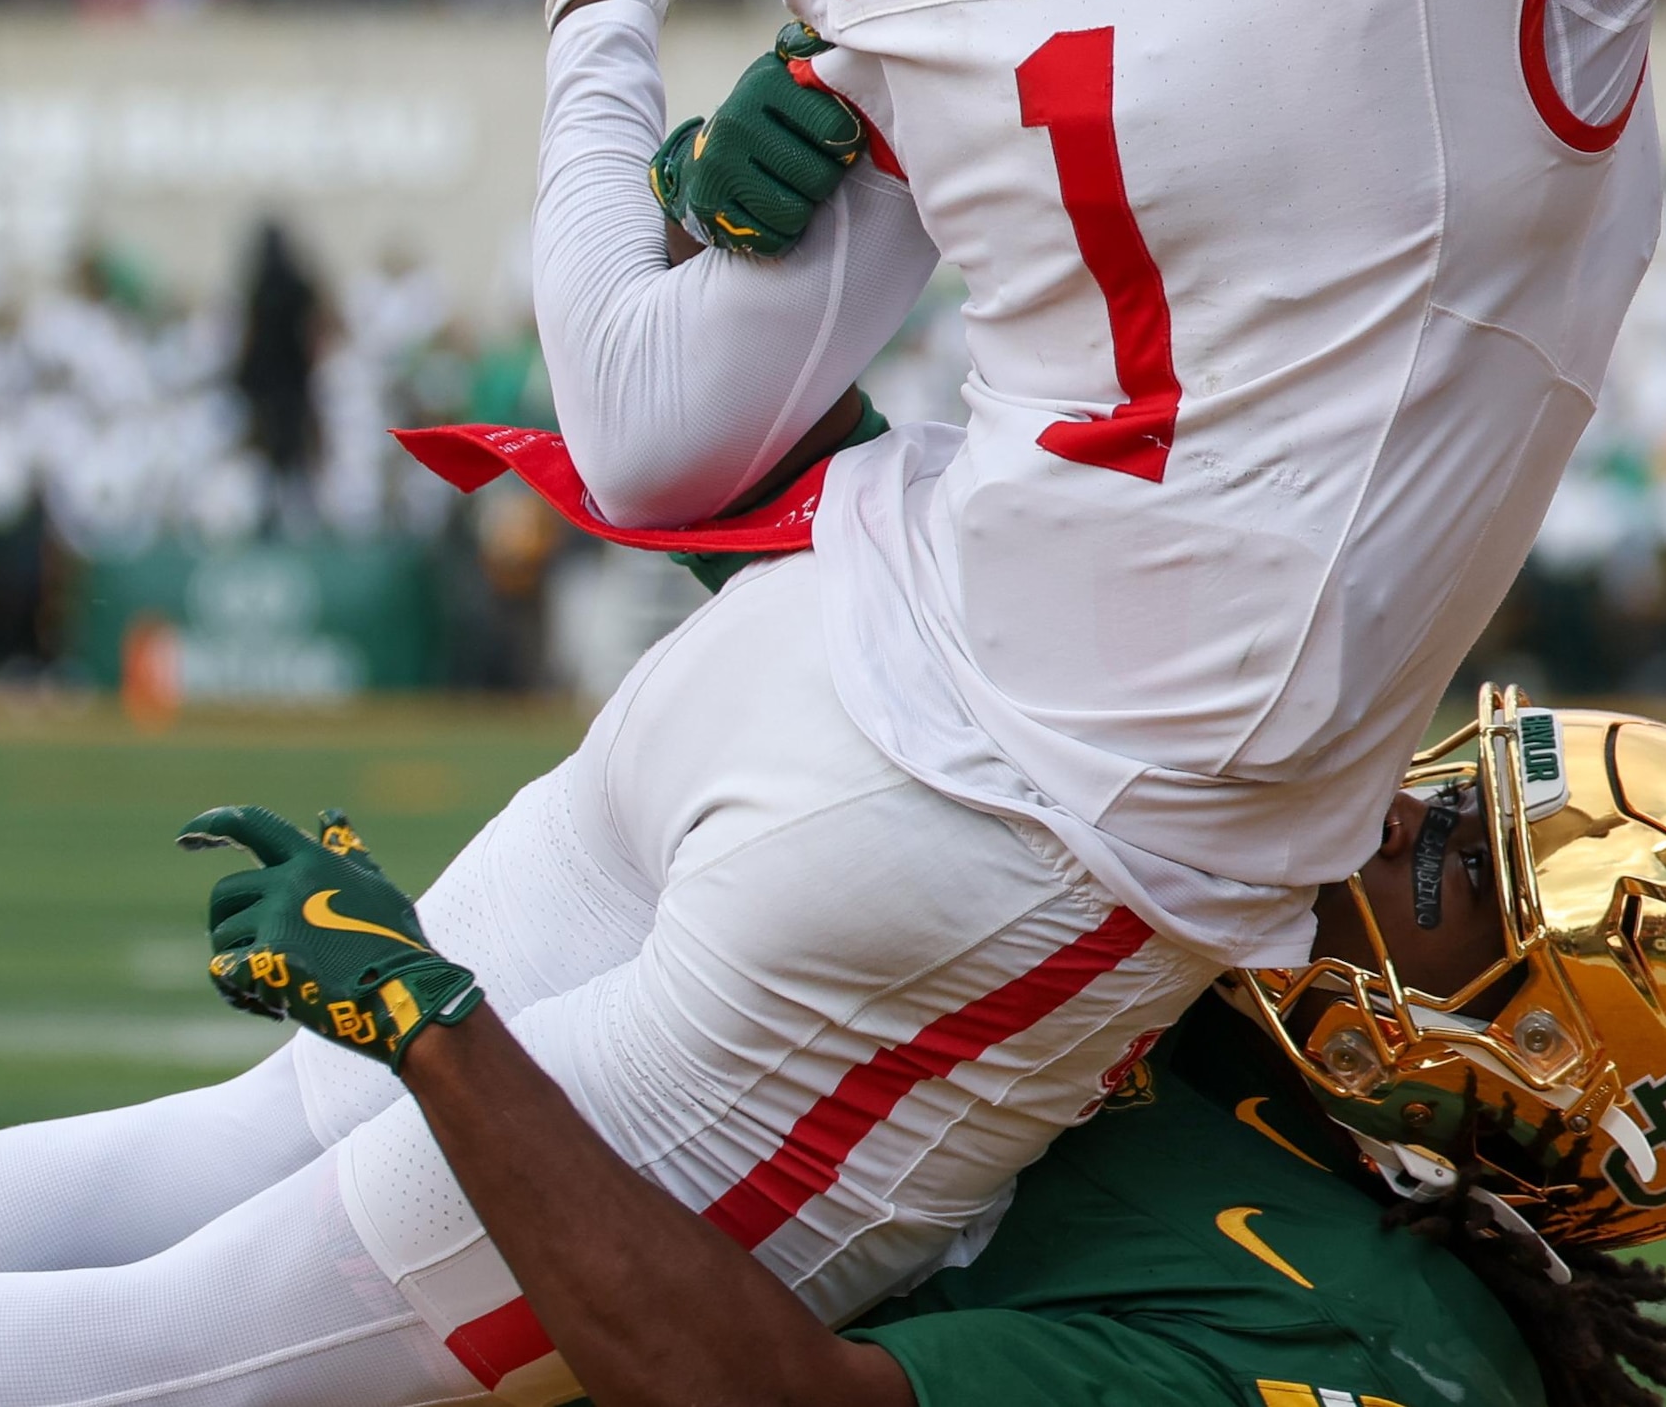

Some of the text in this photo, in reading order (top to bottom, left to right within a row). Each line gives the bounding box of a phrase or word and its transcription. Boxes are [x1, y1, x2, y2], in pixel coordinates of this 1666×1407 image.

[1015, 26, 1182, 483] 1
[249, 950, 291, 988] BU
[327, 1000, 378, 1045] BU
